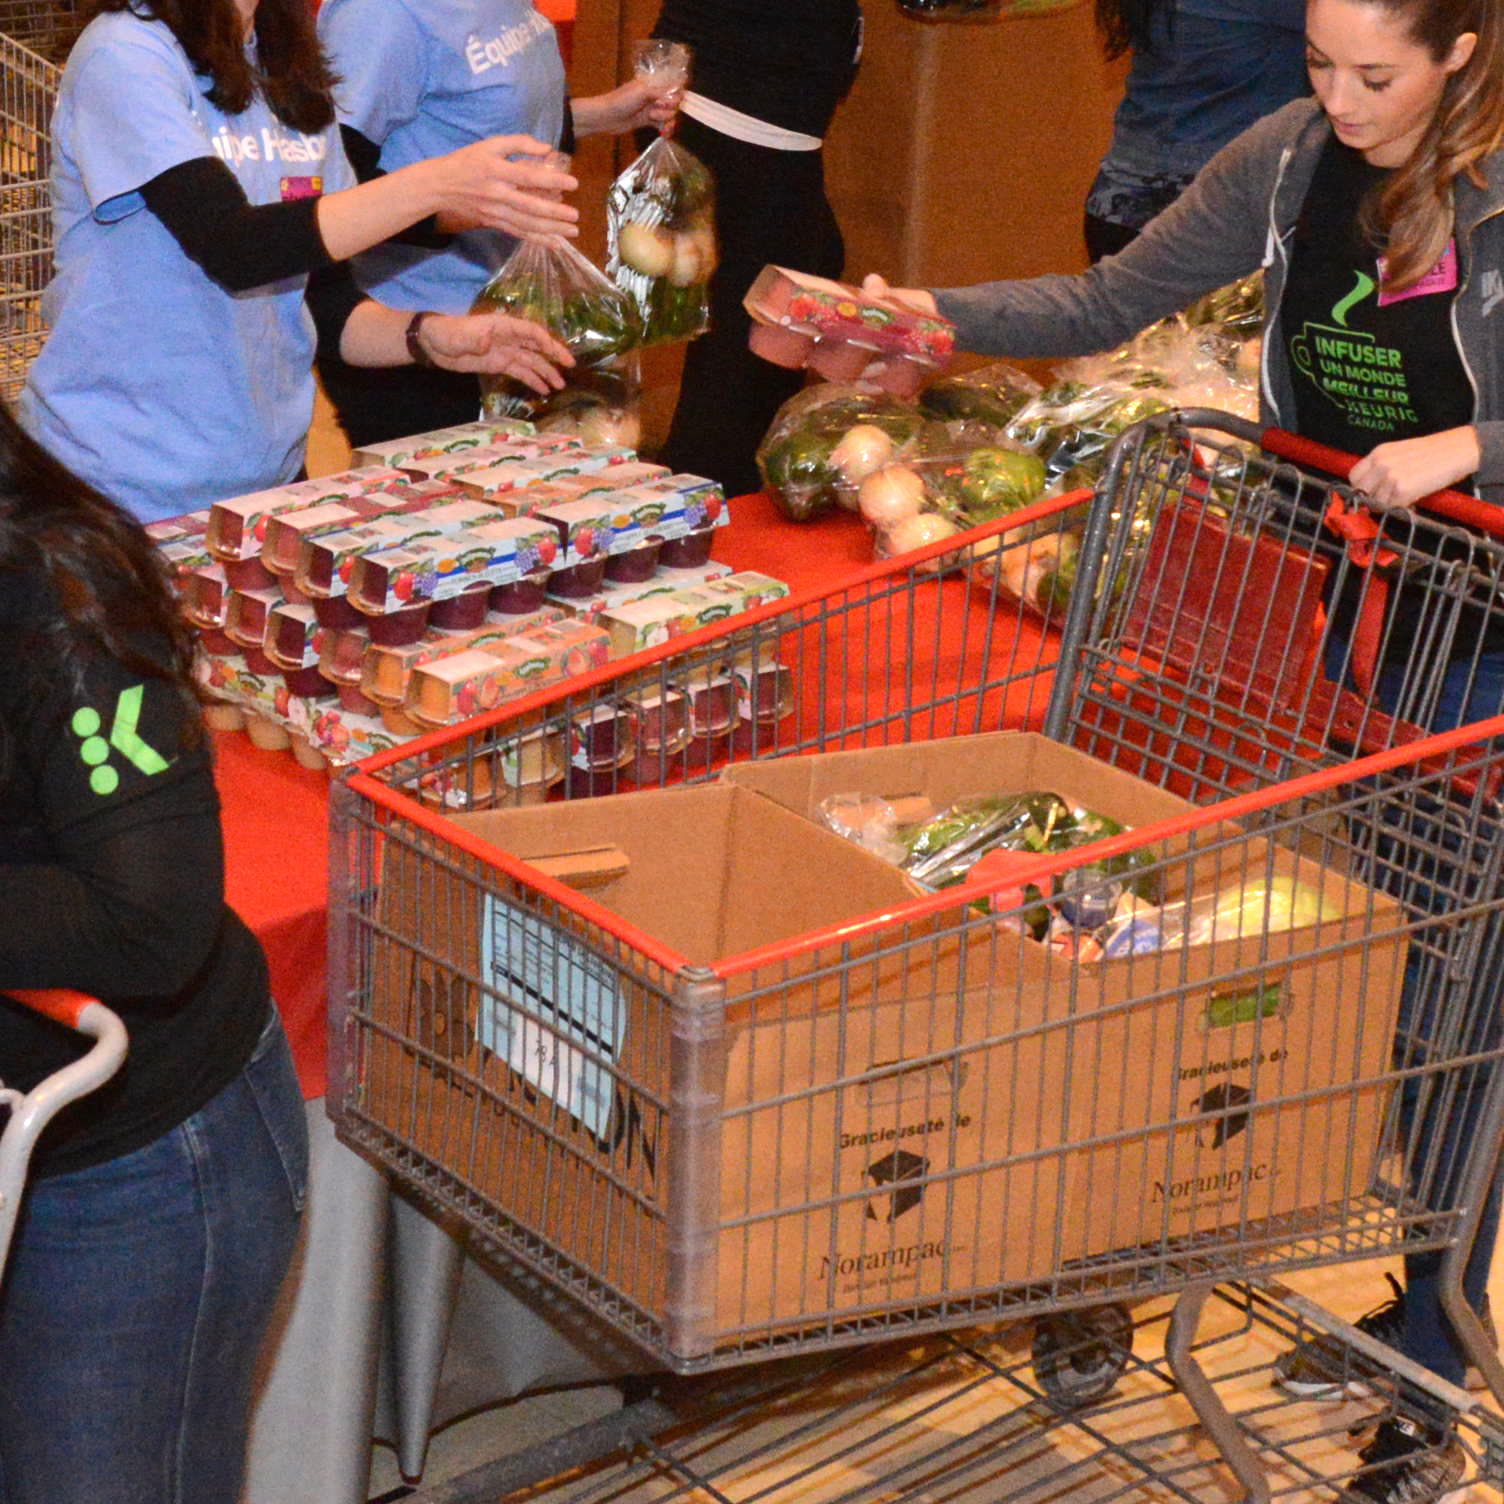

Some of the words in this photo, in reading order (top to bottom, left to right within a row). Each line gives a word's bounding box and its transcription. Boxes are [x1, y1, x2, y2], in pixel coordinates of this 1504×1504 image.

[1315, 336, 1402, 369] INFUSER
[1319, 359, 1343, 376] UN
[1345, 364, 1407, 388] MONDE
[1322, 377, 1409, 405] MEILLEUR
[1345, 399, 1419, 423] KEURIG
[1346, 415, 1395, 431] CANADA
[839, 1116, 945, 1150] Gracieuseté
[820, 1239, 947, 1280] Norampac
